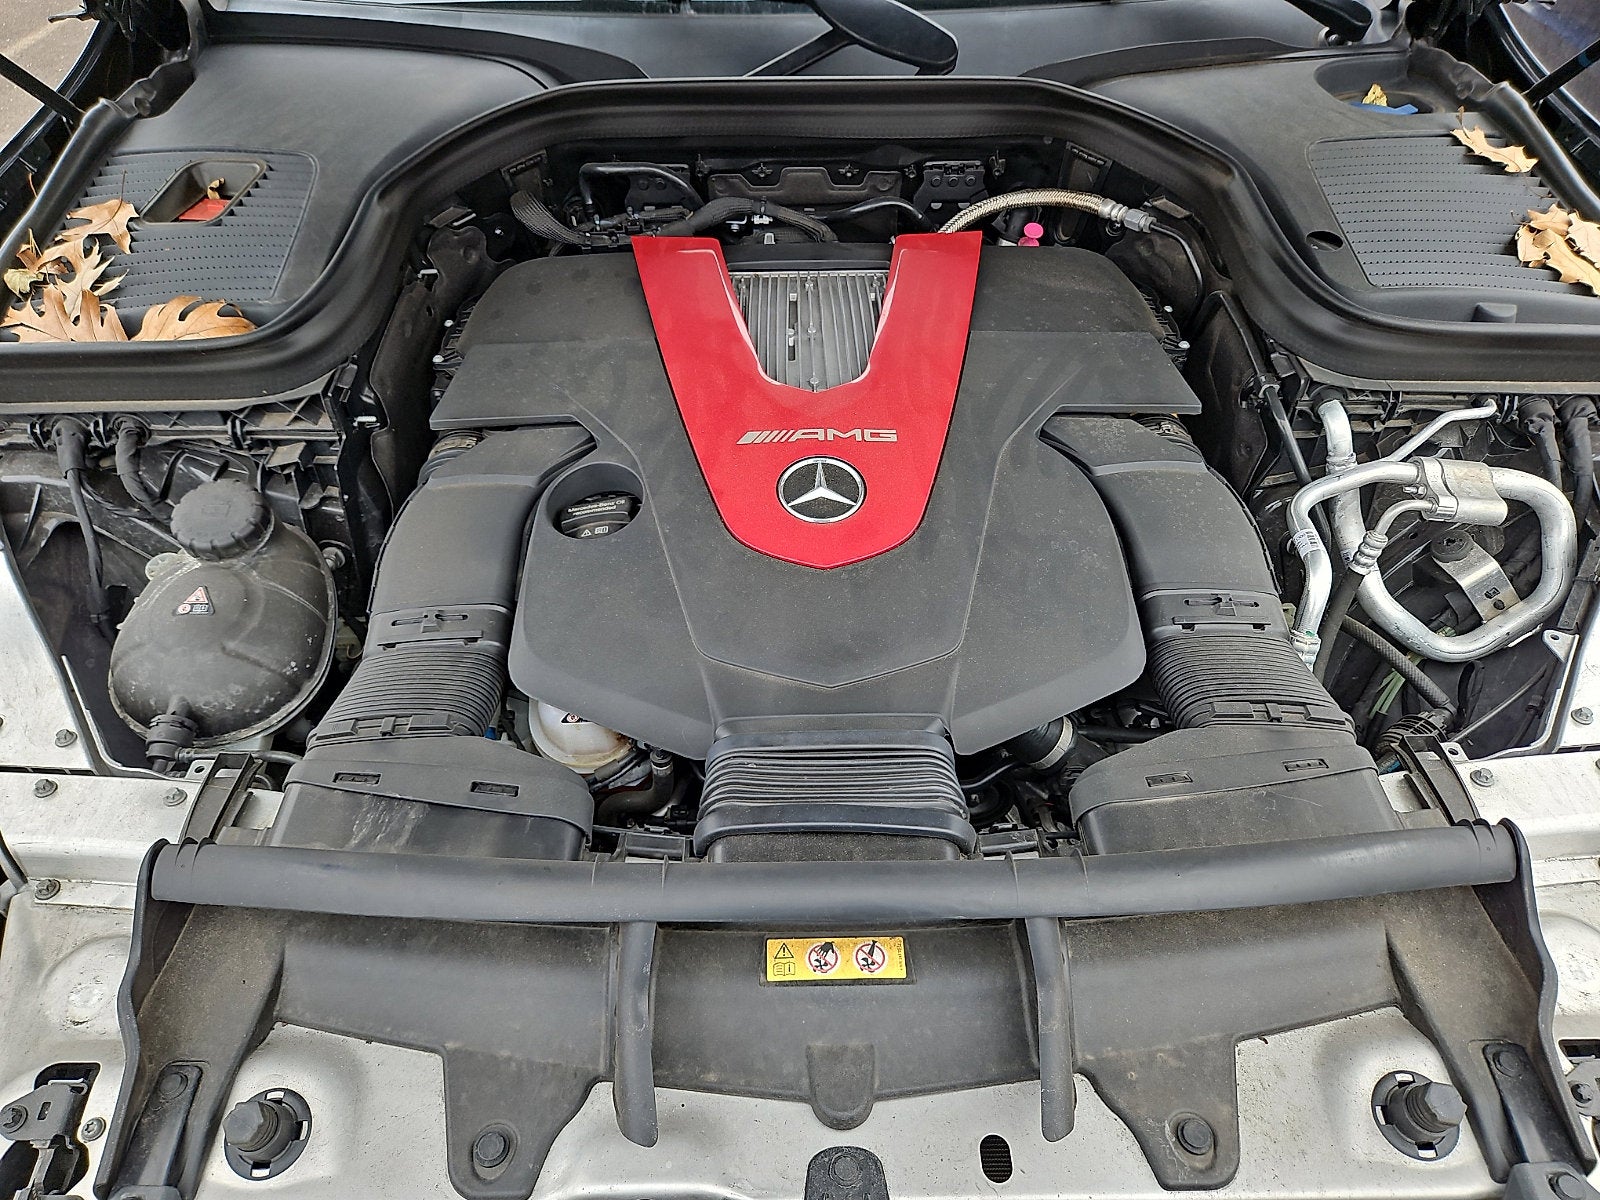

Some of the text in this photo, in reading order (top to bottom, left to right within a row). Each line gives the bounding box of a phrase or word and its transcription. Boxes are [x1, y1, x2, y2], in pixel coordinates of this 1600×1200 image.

[788, 428, 898, 443] AMG
[567, 501, 615, 513] Mercedes-Benz
[572, 504, 617, 516] recommended
